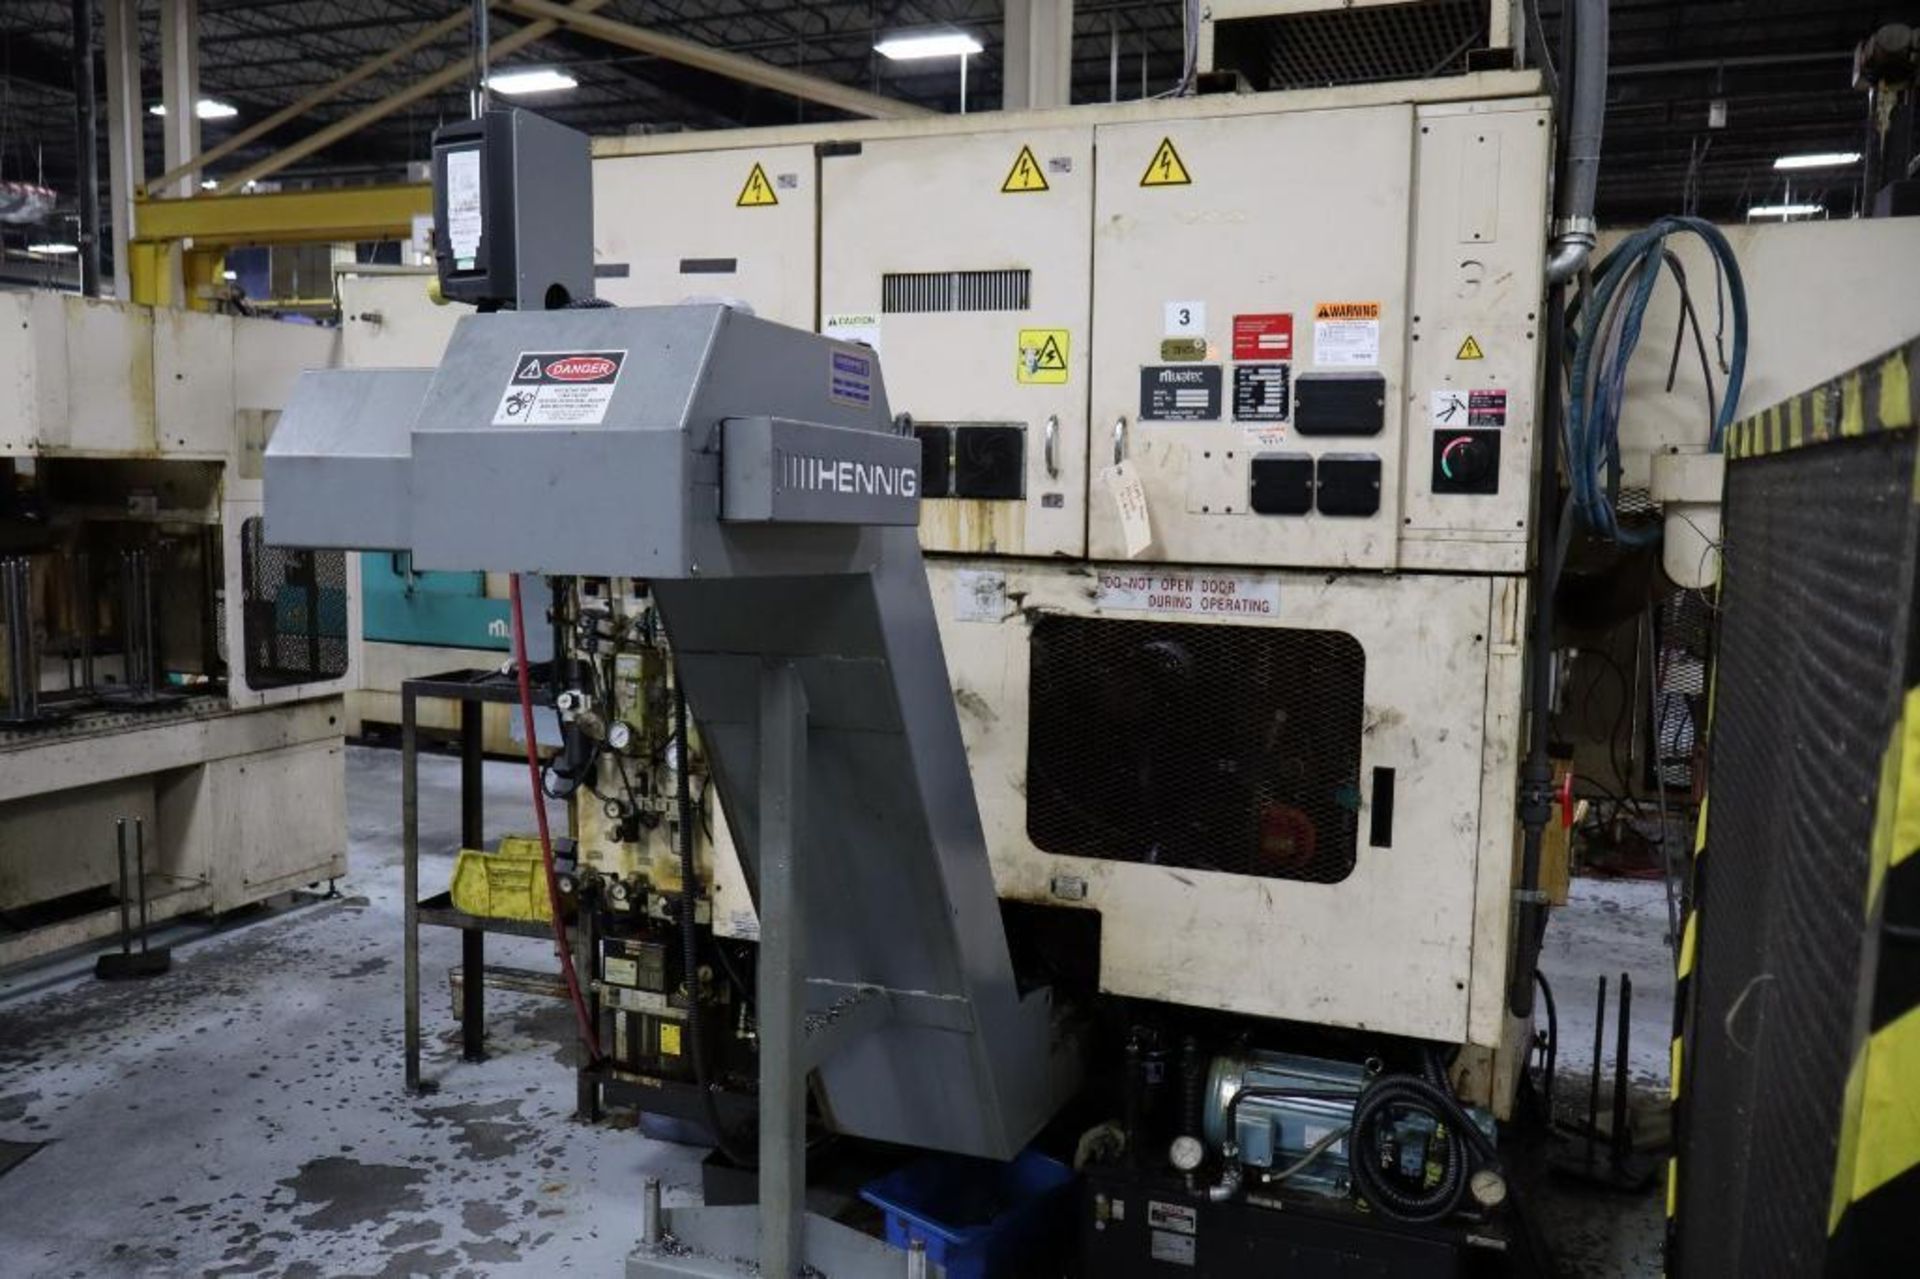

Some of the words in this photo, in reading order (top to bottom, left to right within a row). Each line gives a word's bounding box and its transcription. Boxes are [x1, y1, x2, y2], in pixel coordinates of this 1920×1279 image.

[1179, 308, 1191, 326] 3
[1329, 303, 1378, 318] WARNING
[553, 362, 610, 376] DANGER
[817, 458, 917, 498] HENNIG
[1160, 578, 1194, 593] OPEN
[1201, 579, 1236, 594] DOOR
[1148, 595, 1193, 610] DURING
[1200, 596, 1271, 614] OPERATING
